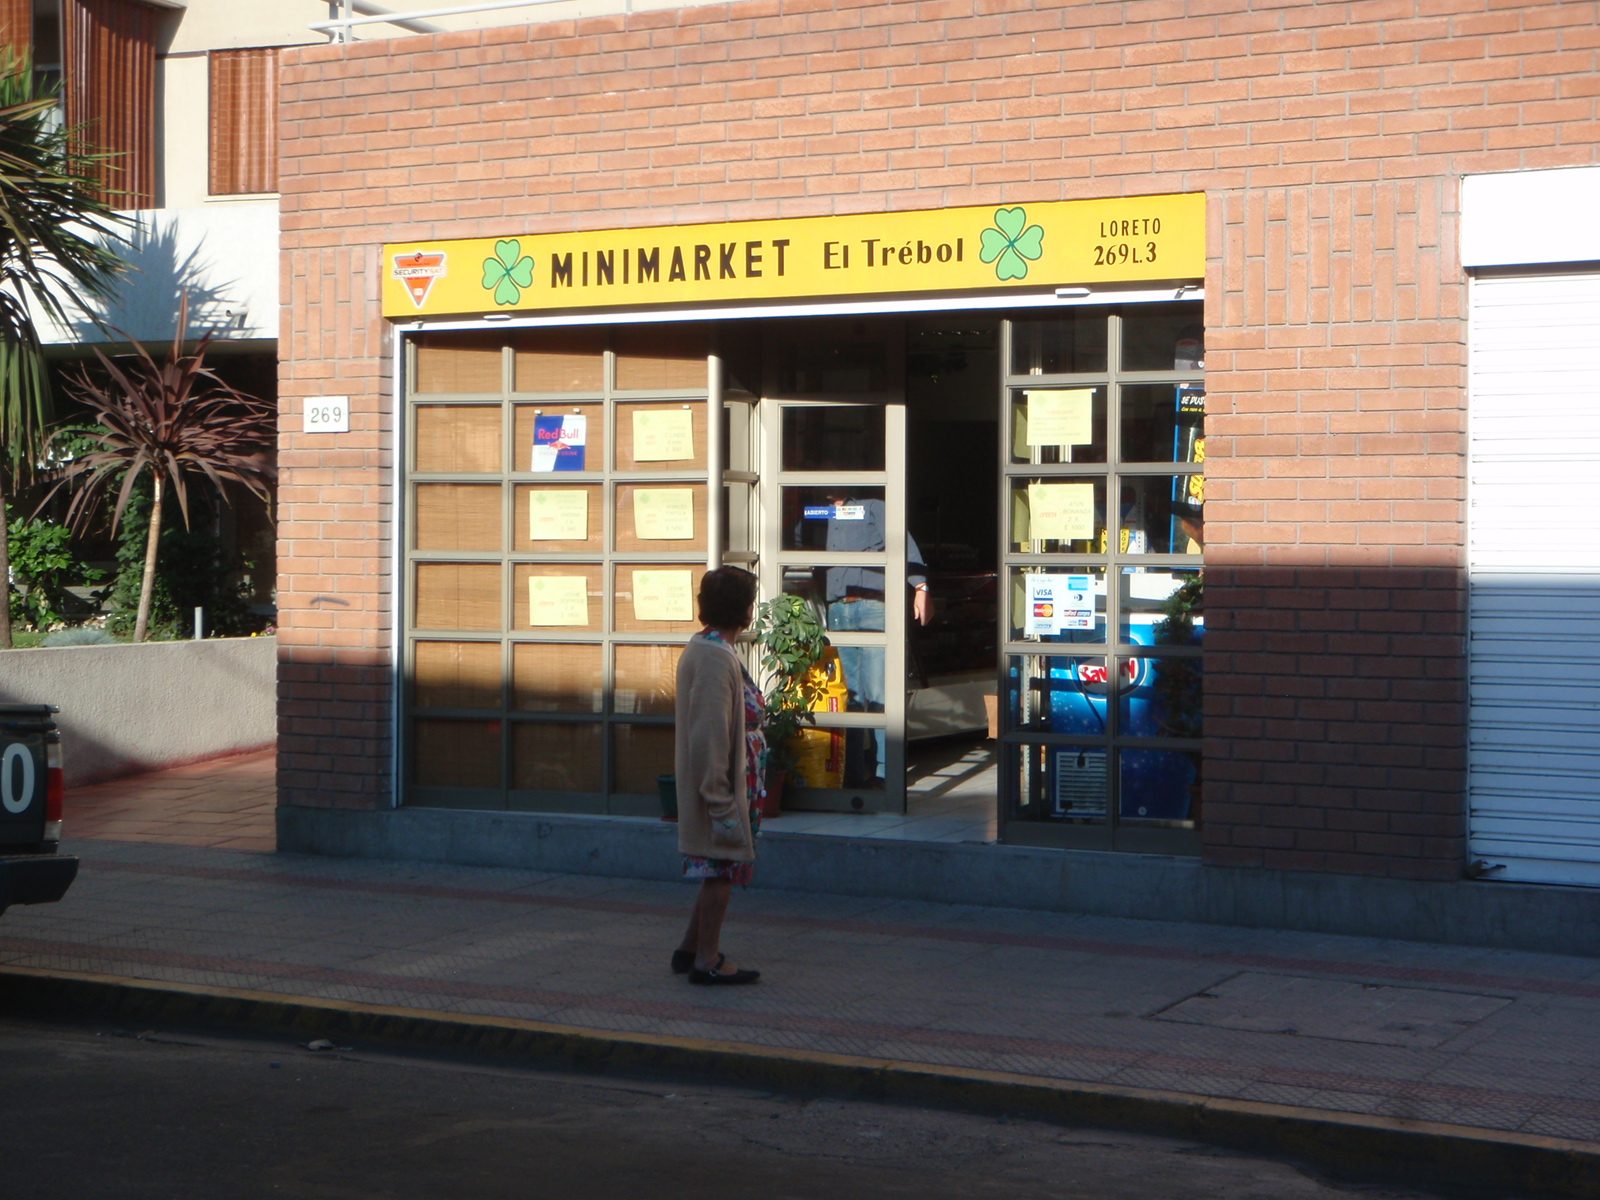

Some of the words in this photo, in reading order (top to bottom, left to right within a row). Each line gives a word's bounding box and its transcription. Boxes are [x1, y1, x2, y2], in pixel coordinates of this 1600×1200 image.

[1100, 218, 1161, 238] LORETO
[551, 239, 790, 288] MINIMARKET
[823, 240, 850, 270] El
[861, 238, 964, 268] Trébol
[310, 406, 342, 423] 269
[537, 427, 559, 440] Red
[559, 427, 579, 440] Bull
[1035, 588, 1053, 597] VISA
